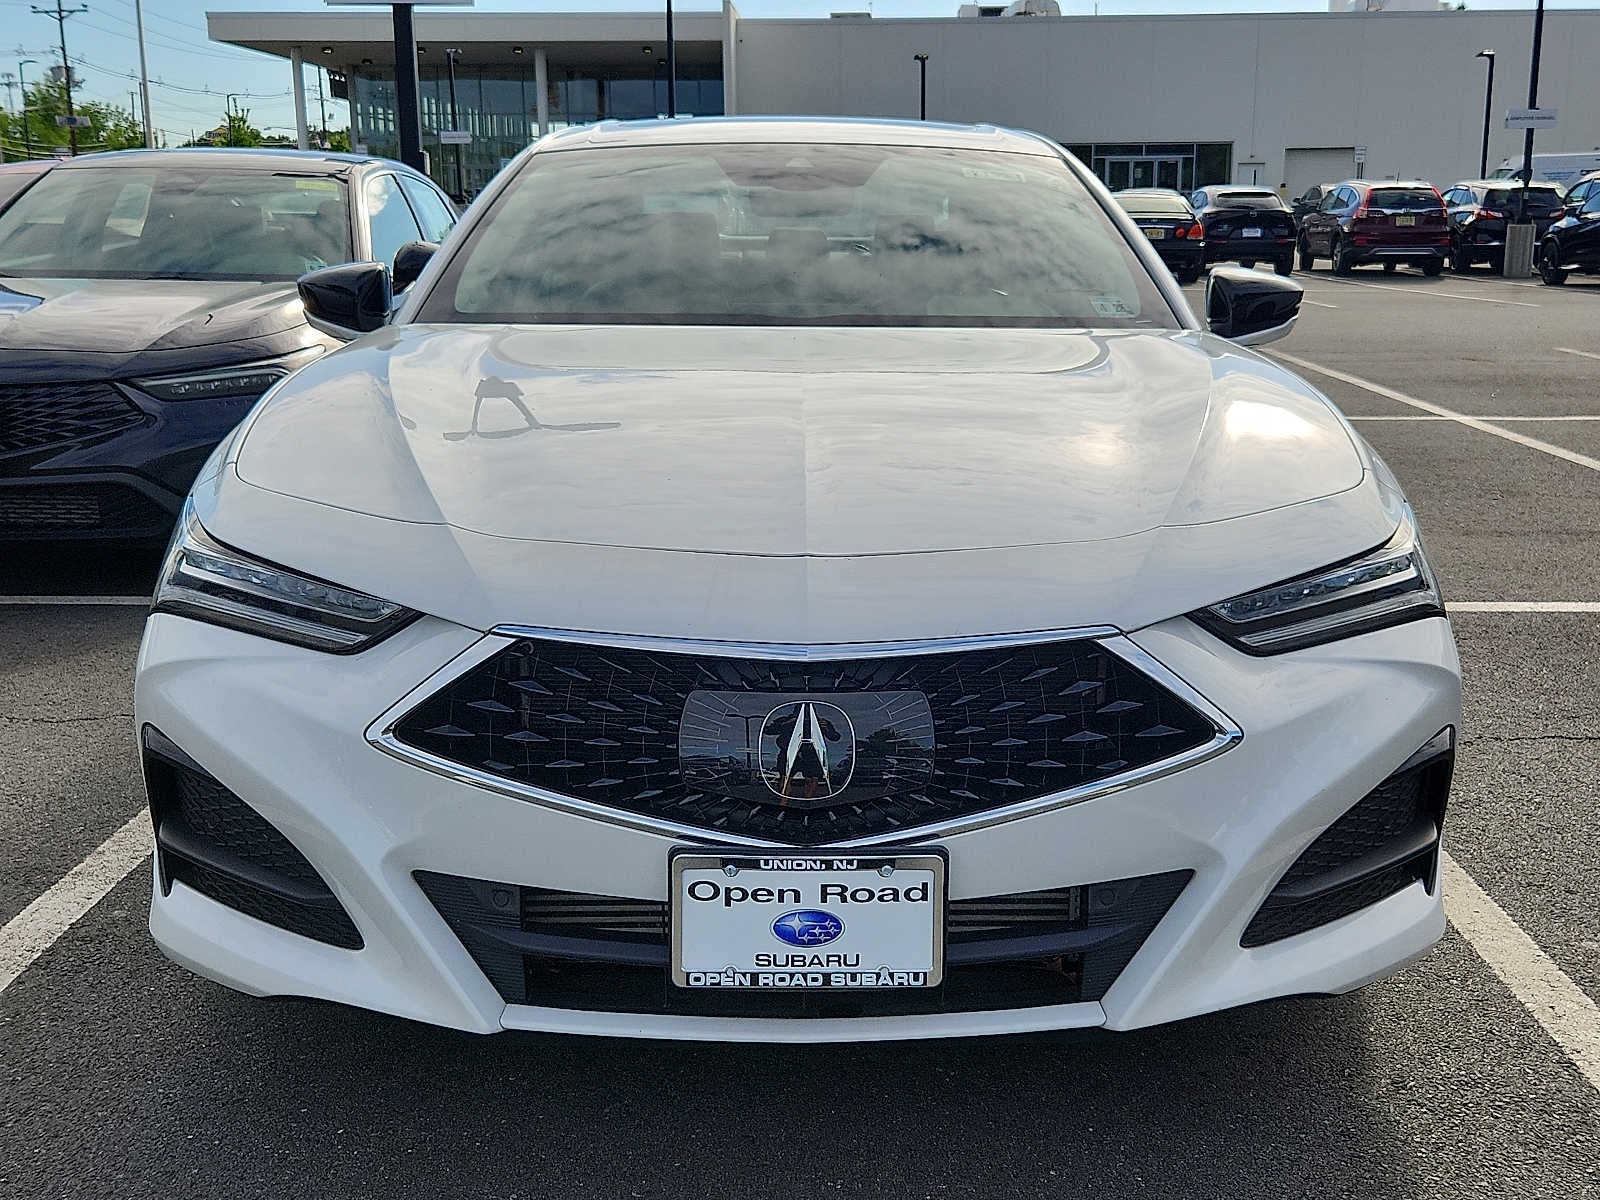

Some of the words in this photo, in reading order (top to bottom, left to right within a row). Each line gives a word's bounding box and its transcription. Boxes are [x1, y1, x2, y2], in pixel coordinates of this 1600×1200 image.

[759, 859, 826, 871] UNION,
[833, 859, 858, 870] NJ
[687, 880, 801, 908] Open
[819, 881, 929, 904] Road
[755, 953, 860, 968] SUBARU
[689, 972, 750, 987] OPEN
[758, 973, 823, 986] ROAD
[830, 973, 925, 986] SUBARU
